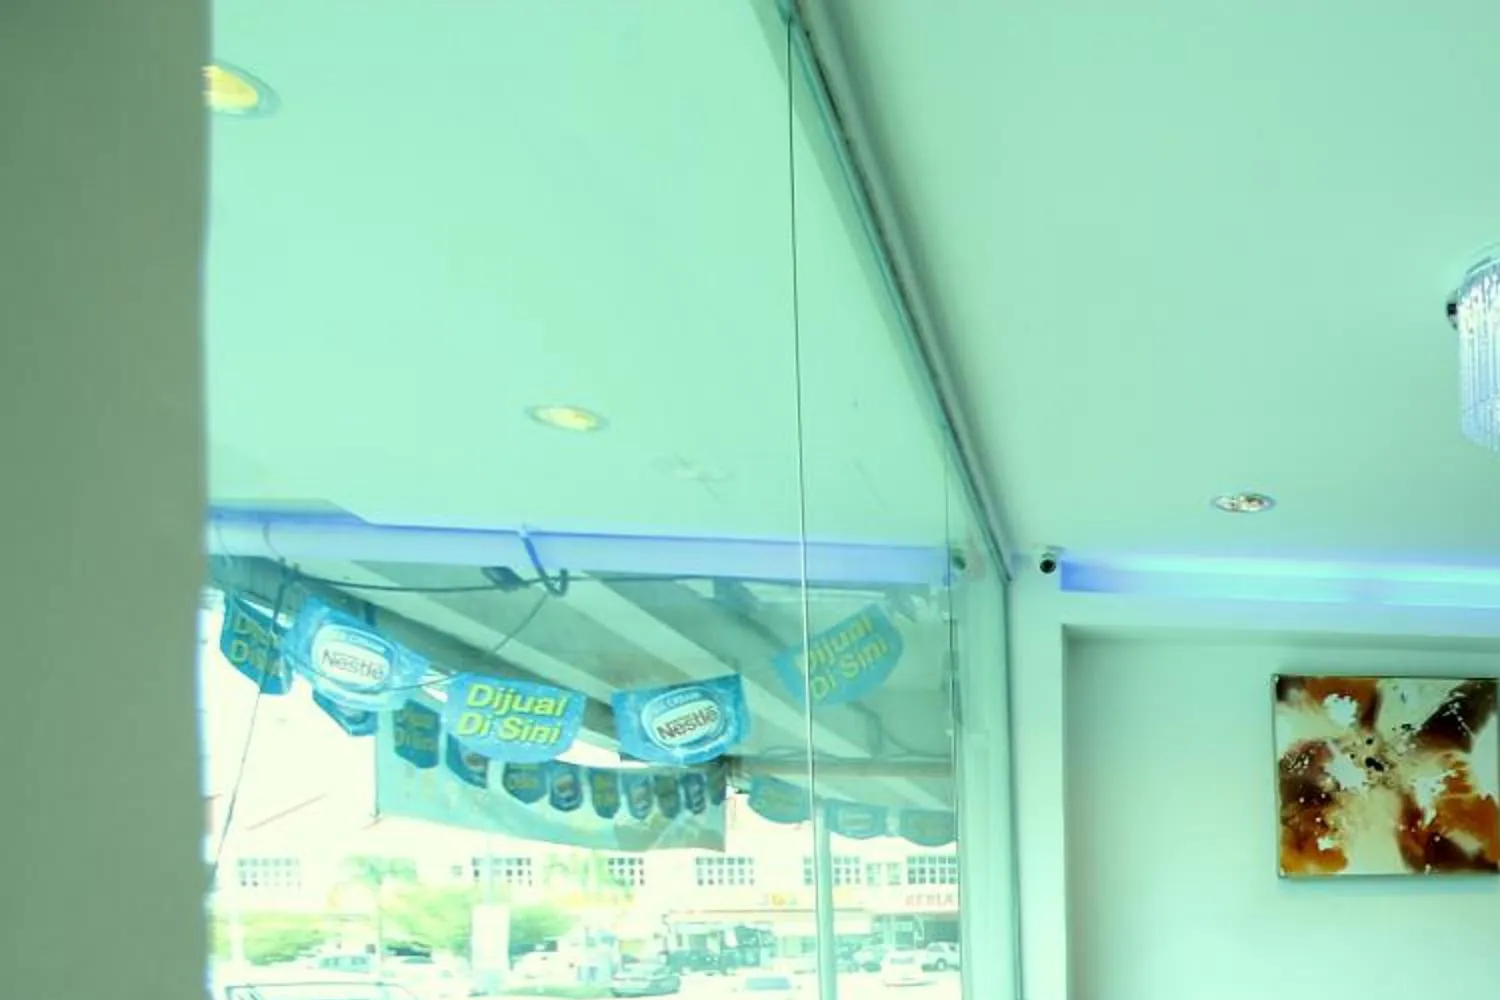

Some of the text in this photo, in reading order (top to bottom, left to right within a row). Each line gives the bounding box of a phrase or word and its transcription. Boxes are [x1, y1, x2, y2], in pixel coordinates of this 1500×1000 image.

[467, 683, 568, 717] Dijual
[457, 711, 492, 737] Di
[497, 716, 562, 744] Sini
